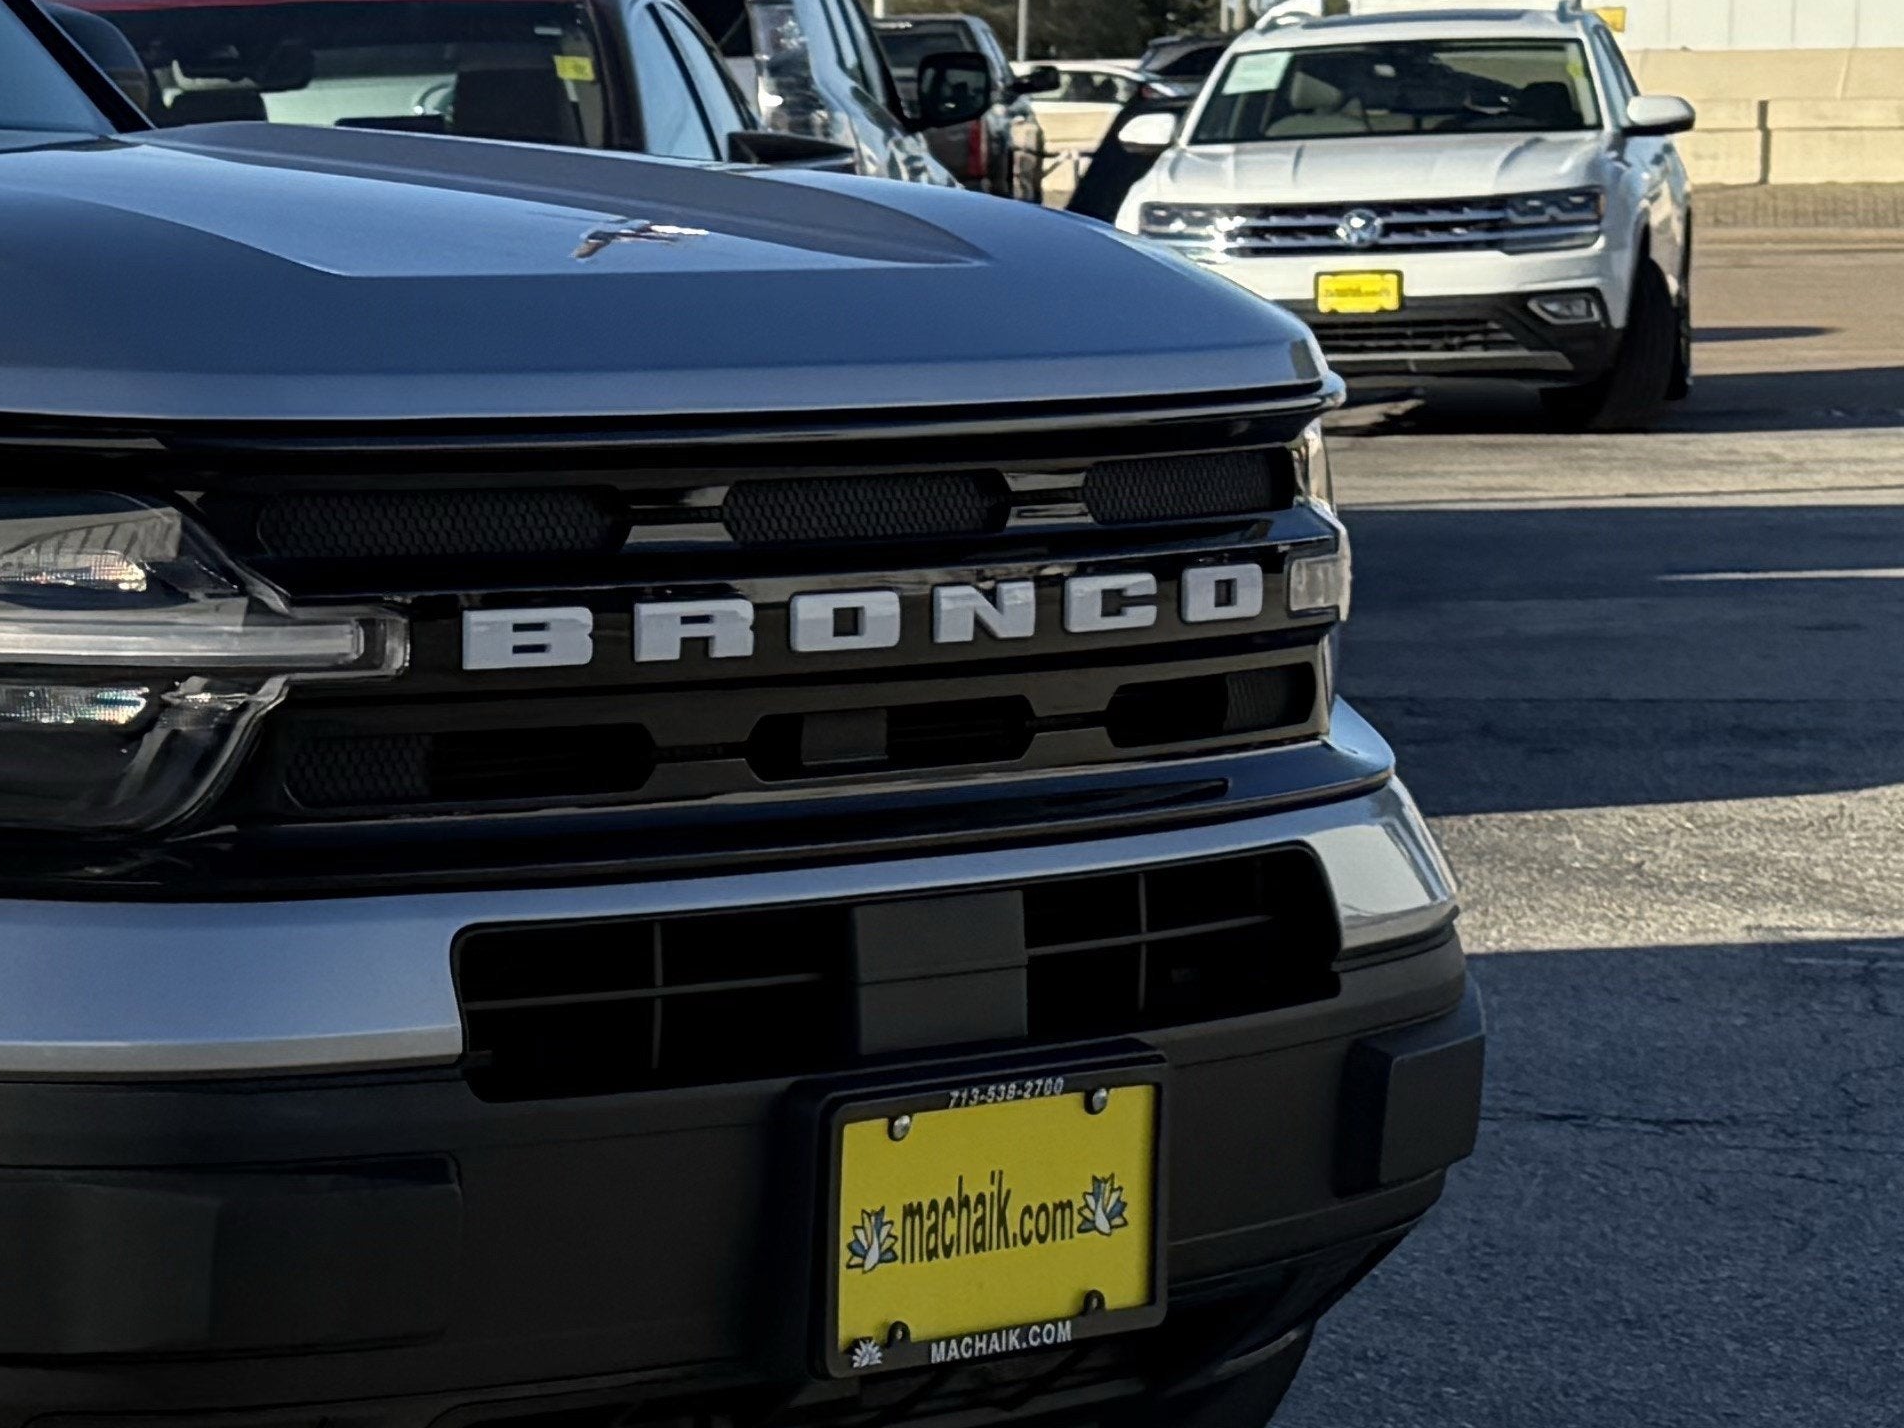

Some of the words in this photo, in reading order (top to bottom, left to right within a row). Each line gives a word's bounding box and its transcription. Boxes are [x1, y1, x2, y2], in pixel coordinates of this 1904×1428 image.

[461, 562, 1263, 670] BRONCO
[948, 1077, 1065, 1109] 713-538-2700
[901, 1170, 1074, 1265] machaik.com
[930, 1320, 1073, 1364] MACHAIK.COM
